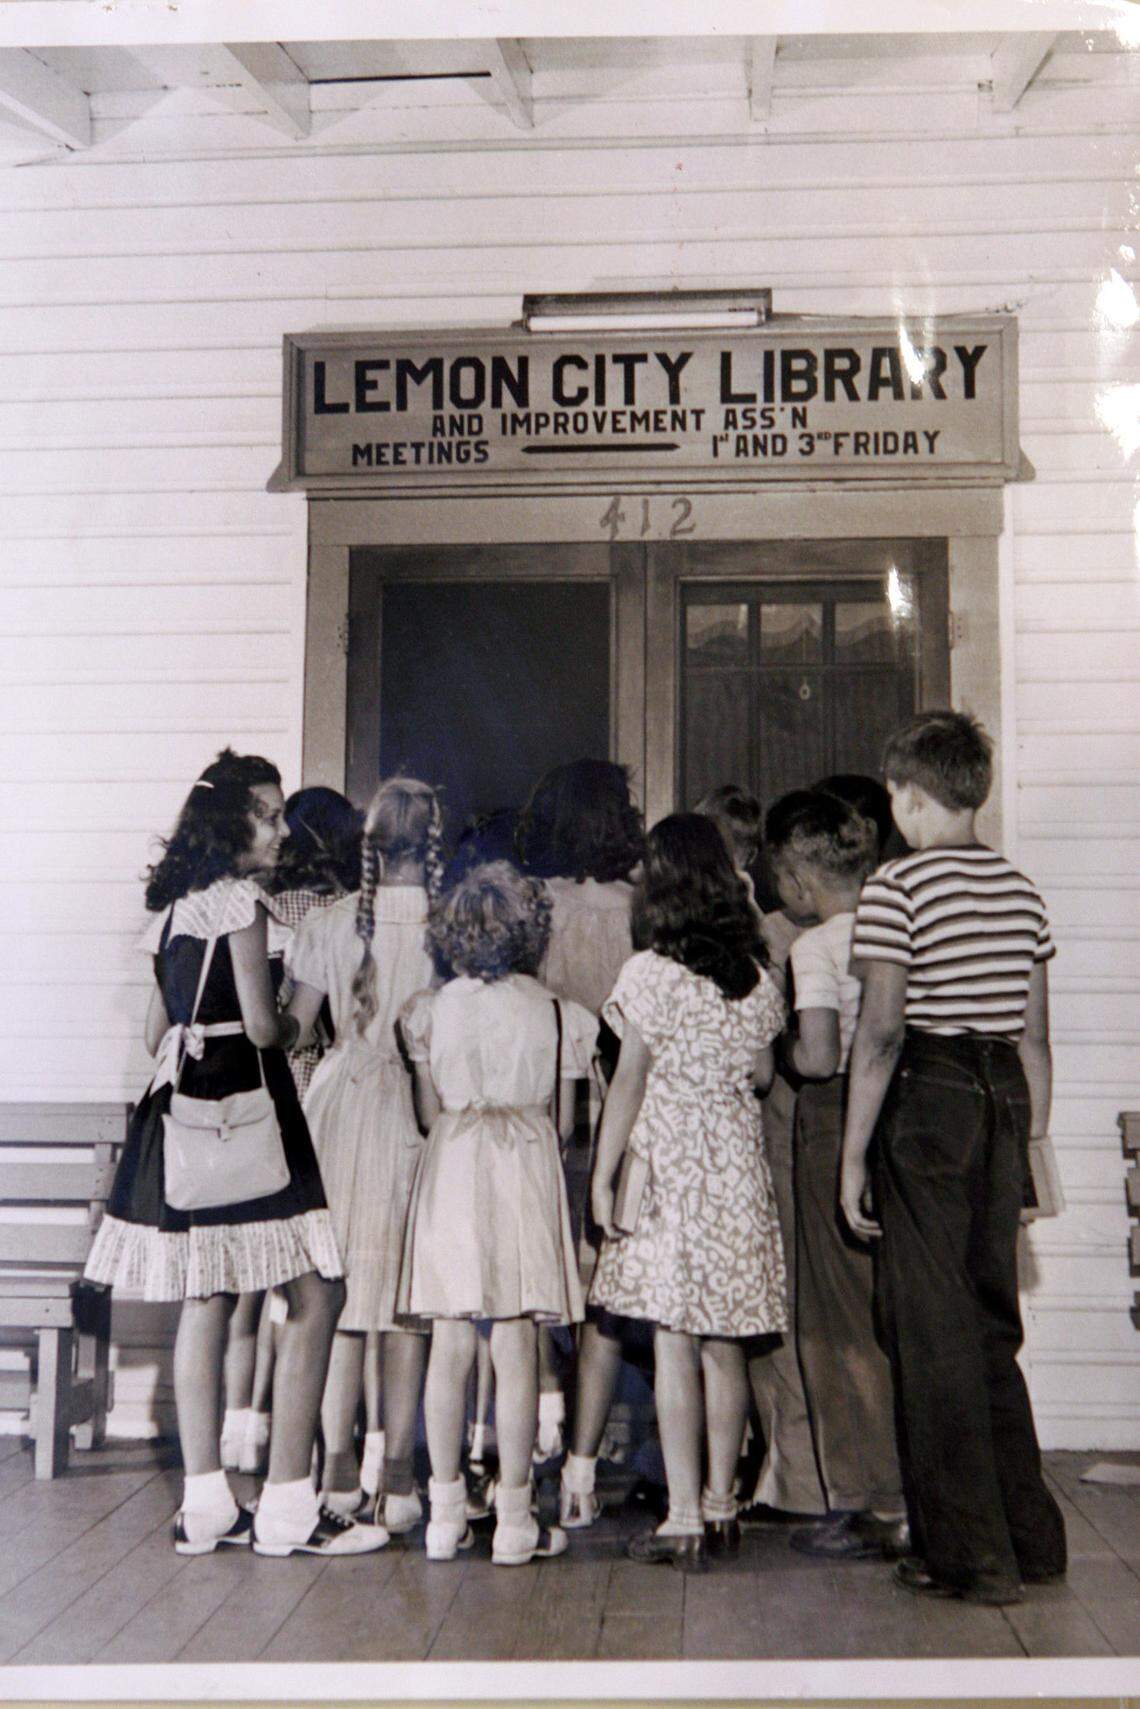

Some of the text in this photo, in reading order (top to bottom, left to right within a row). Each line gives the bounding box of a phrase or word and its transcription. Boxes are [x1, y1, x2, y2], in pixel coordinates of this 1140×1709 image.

[313, 345, 987, 414] LEMON CITY LIBRARY
[431, 414, 483, 437] AND
[501, 409, 705, 436] IMPROVEMENT
[351, 441, 489, 466] MEETINGS
[735, 434, 788, 457] AND
[834, 430, 941, 455] FRIDAY
[600, 495, 696, 541] 412
